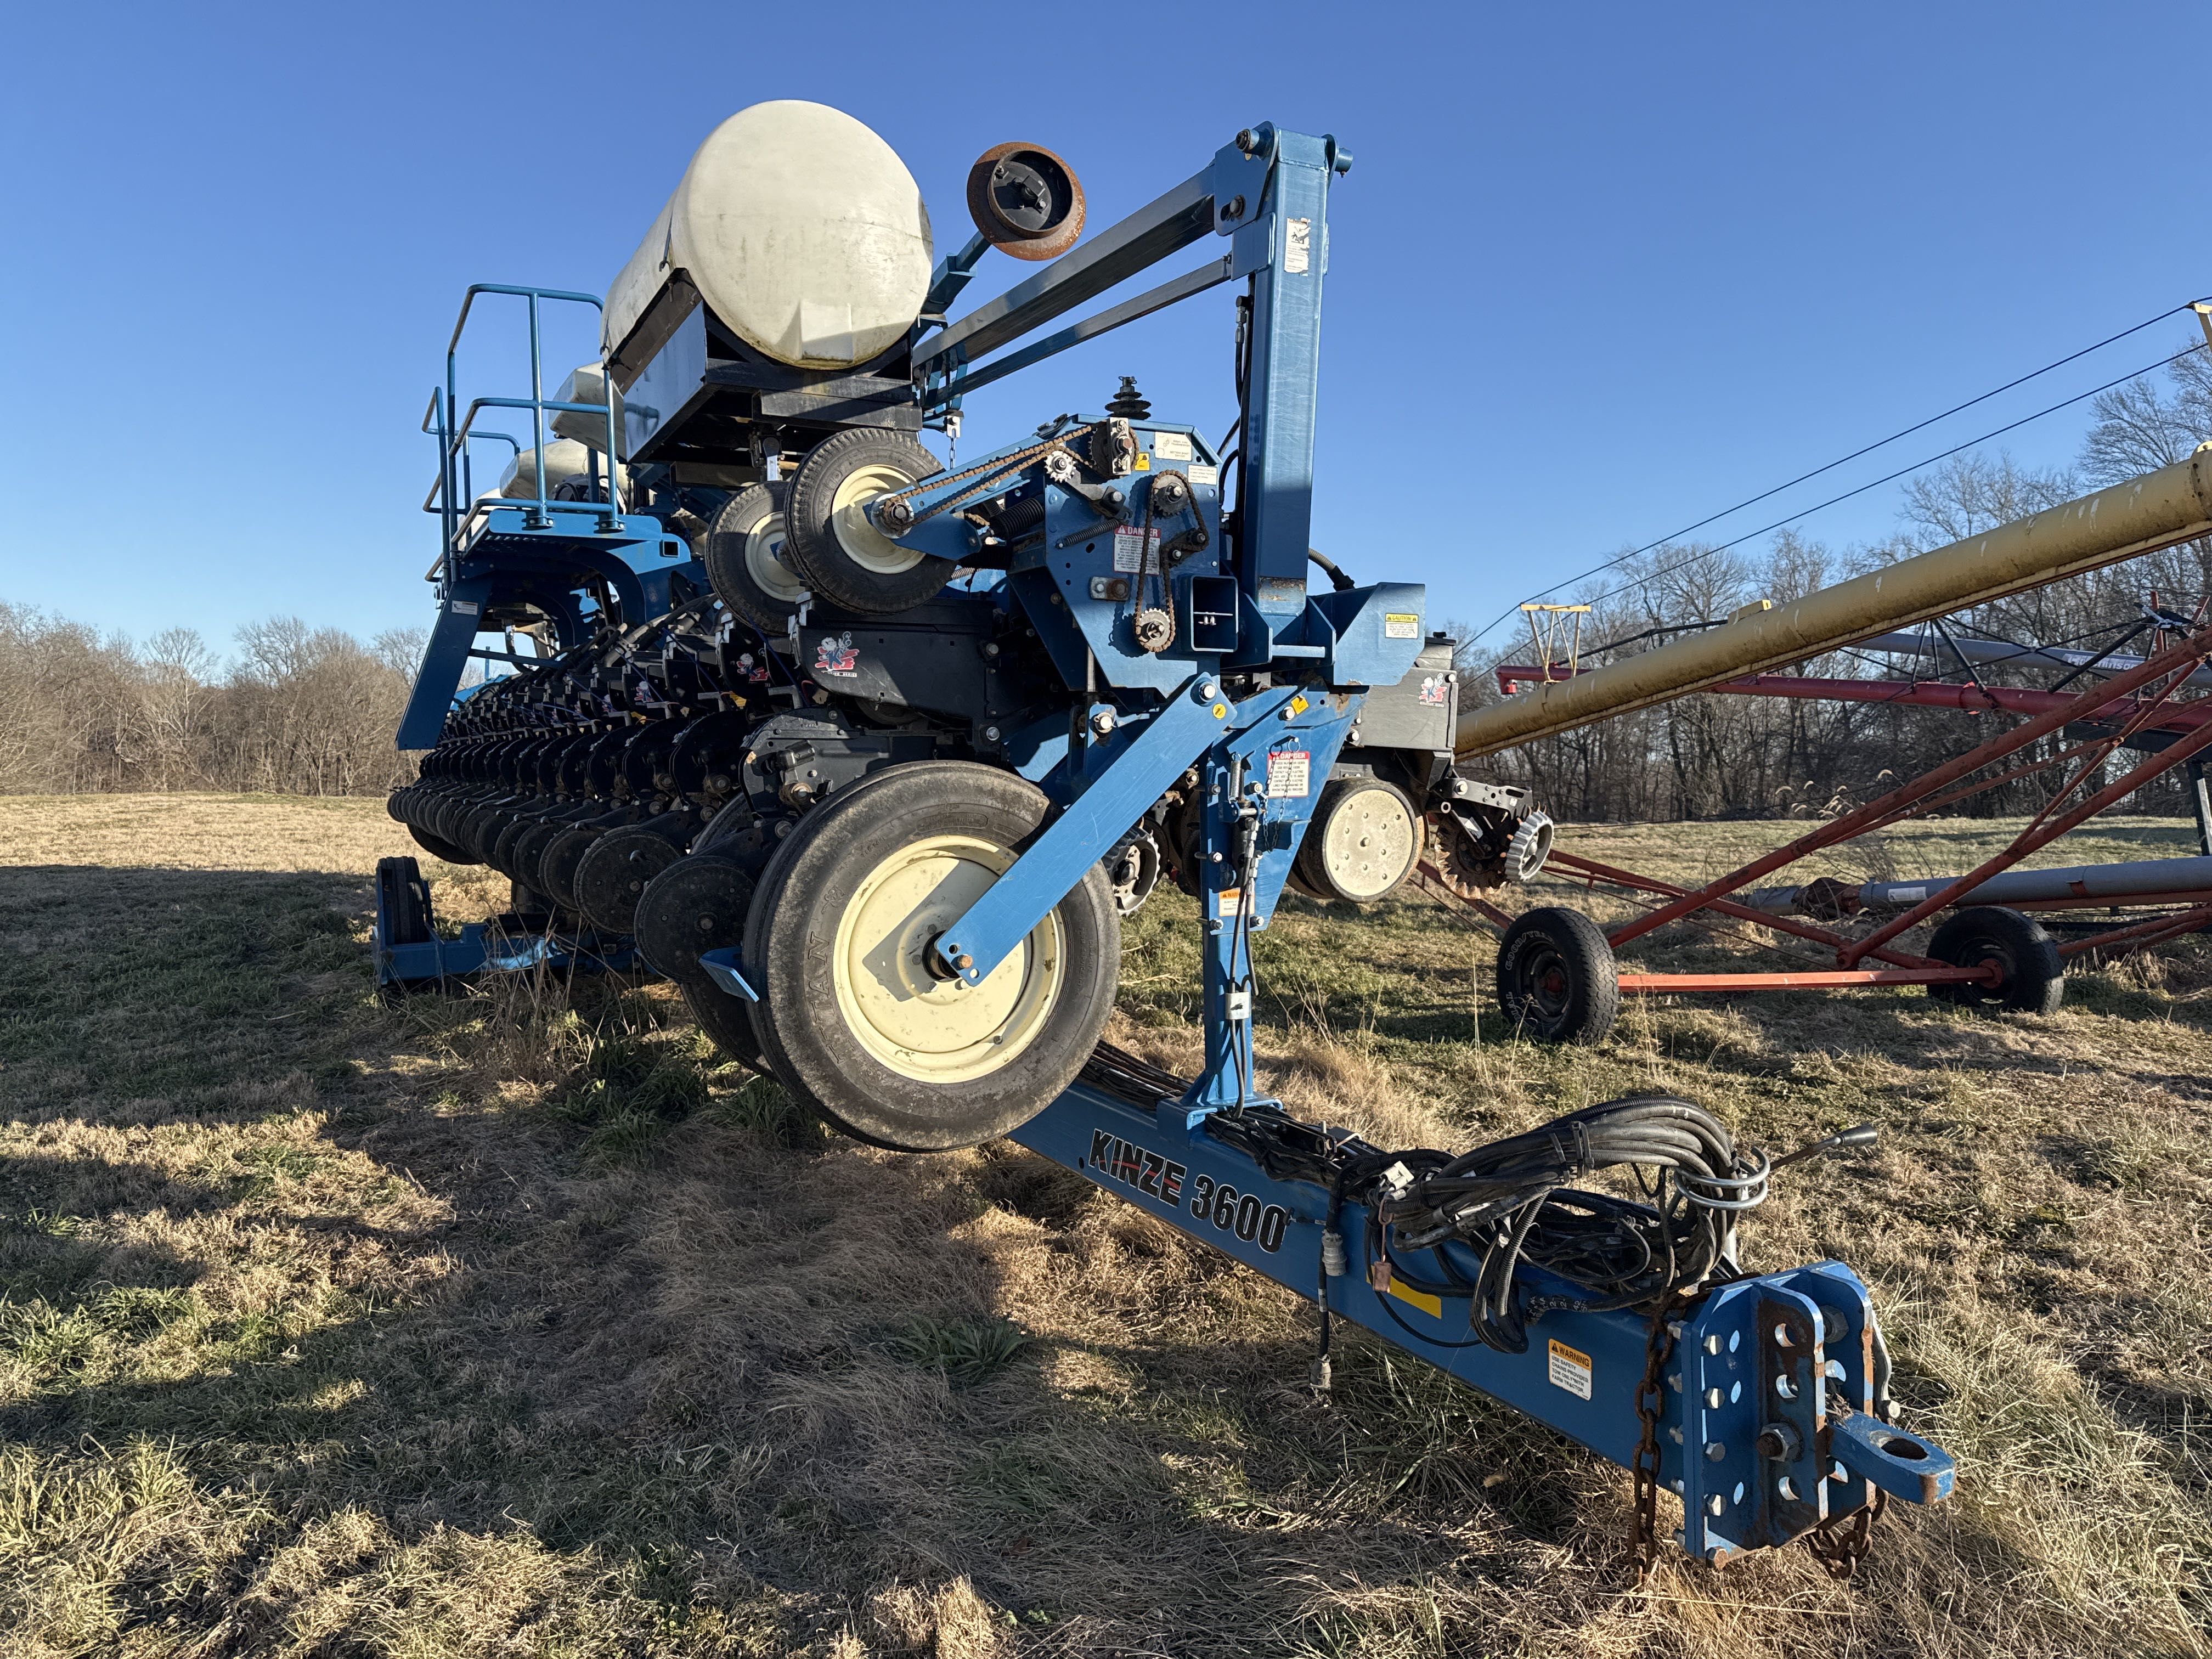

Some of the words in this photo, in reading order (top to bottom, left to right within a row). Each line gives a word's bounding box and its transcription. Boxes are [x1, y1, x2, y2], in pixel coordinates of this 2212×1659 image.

[2068, 656, 2138, 670] Huhinso
[808, 931, 855, 1064] TITAN
[1088, 1128, 1188, 1207] KINZE
[1189, 1173, 1286, 1254] 3600
[1551, 1355, 1560, 1363] USE
[1561, 1359, 1576, 1370] SAFETY
[1559, 1346, 1589, 1367] WARNING
[1551, 1362, 1567, 1373] CHAINS
[1551, 1368, 1561, 1376] TOW
